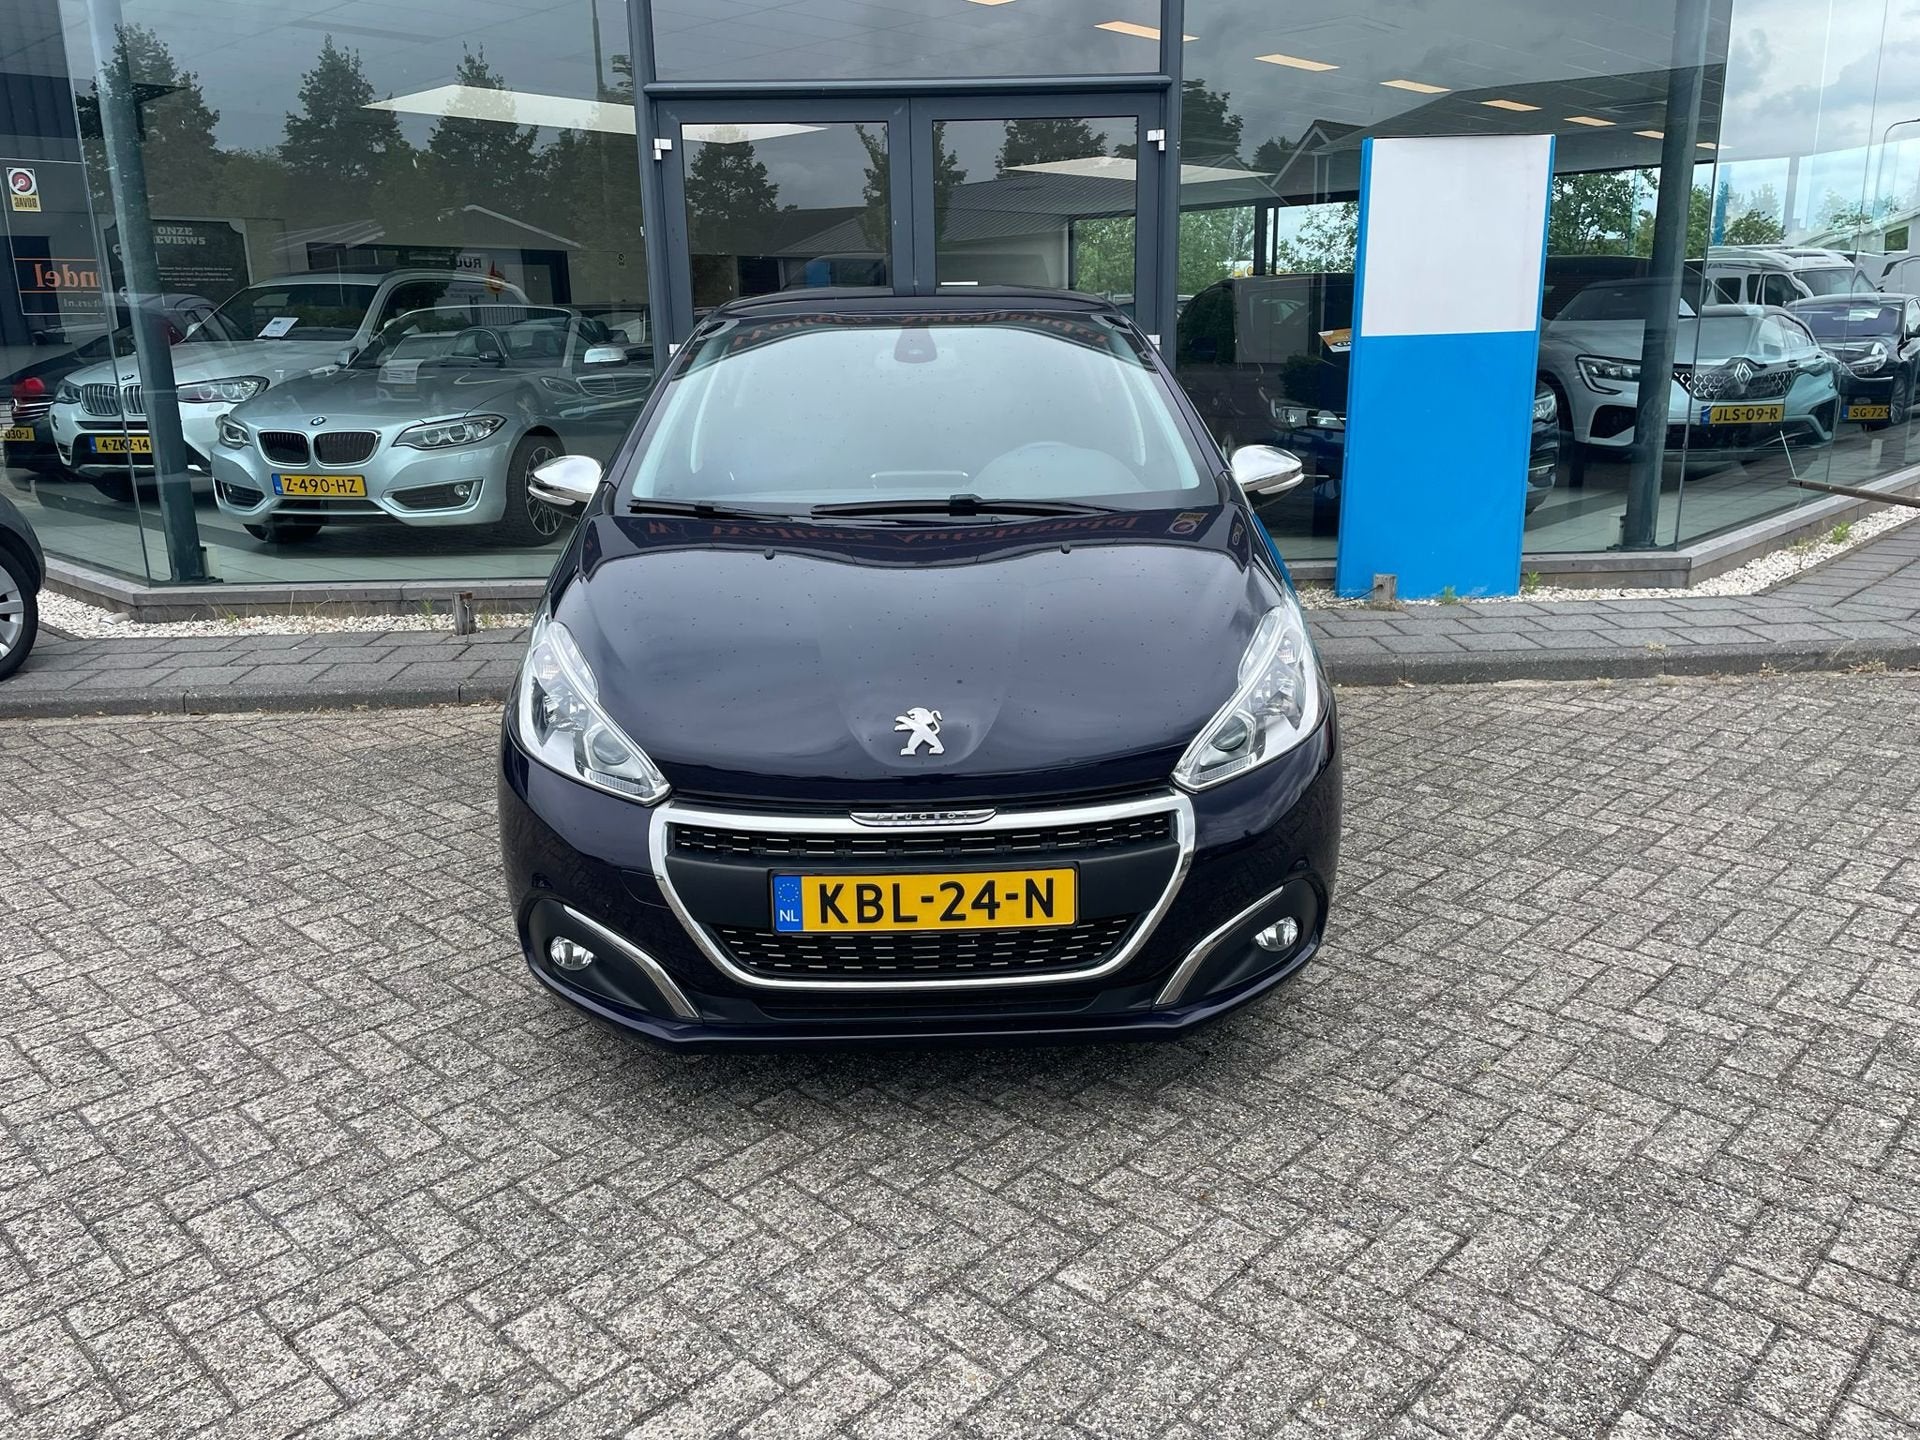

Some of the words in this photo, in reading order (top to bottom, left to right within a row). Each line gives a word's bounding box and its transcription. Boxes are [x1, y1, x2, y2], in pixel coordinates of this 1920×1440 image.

[158, 227, 193, 235] ONZE
[1715, 407, 1778, 421] JLS-09-R
[284, 478, 358, 493] Z-490-HZ
[819, 877, 1055, 924] KBL-24-N
[779, 909, 800, 922] NL
